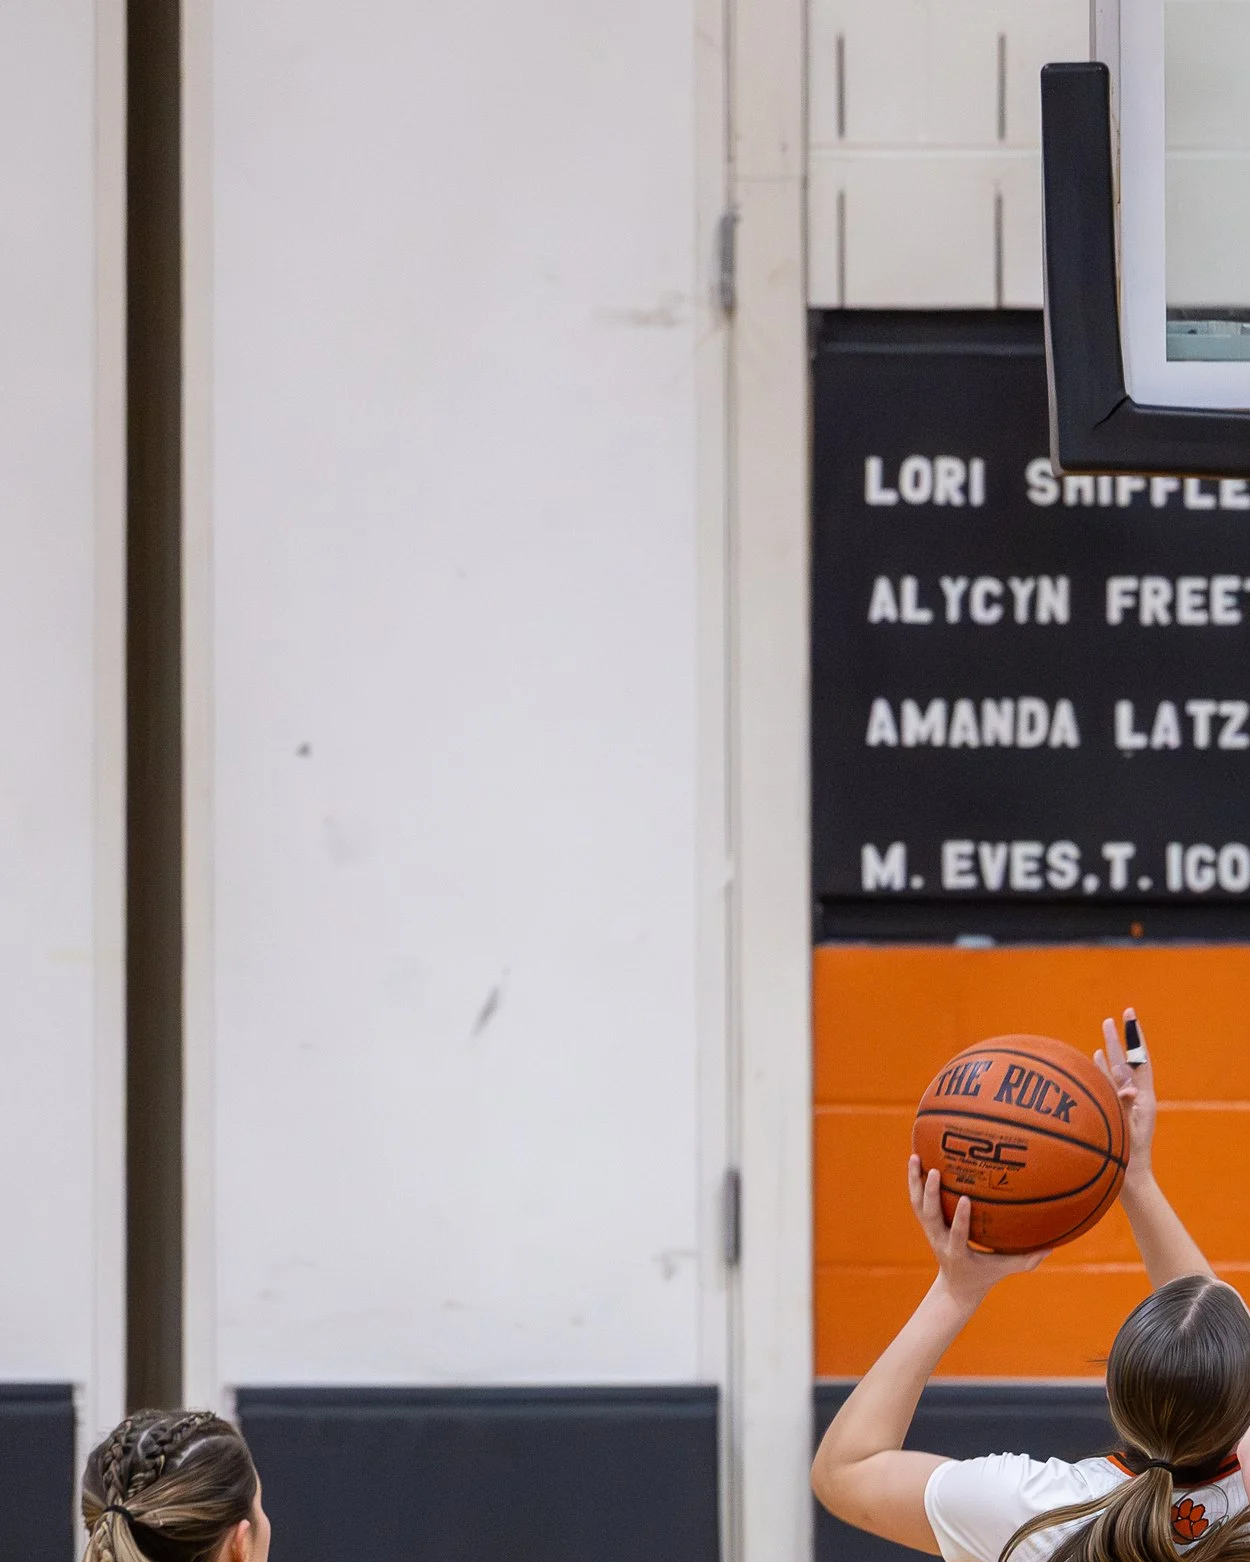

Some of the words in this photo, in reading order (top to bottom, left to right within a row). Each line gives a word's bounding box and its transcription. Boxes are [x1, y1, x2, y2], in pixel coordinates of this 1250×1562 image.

[864, 455, 985, 507] LORI
[868, 575, 1070, 625] ALYCYN
[866, 697, 1080, 749] AMANDA
[1114, 699, 1250, 750] LATZ
[861, 841, 924, 891] M.
[935, 1060, 992, 1097] THE
[993, 1064, 1077, 1123] ROCK
